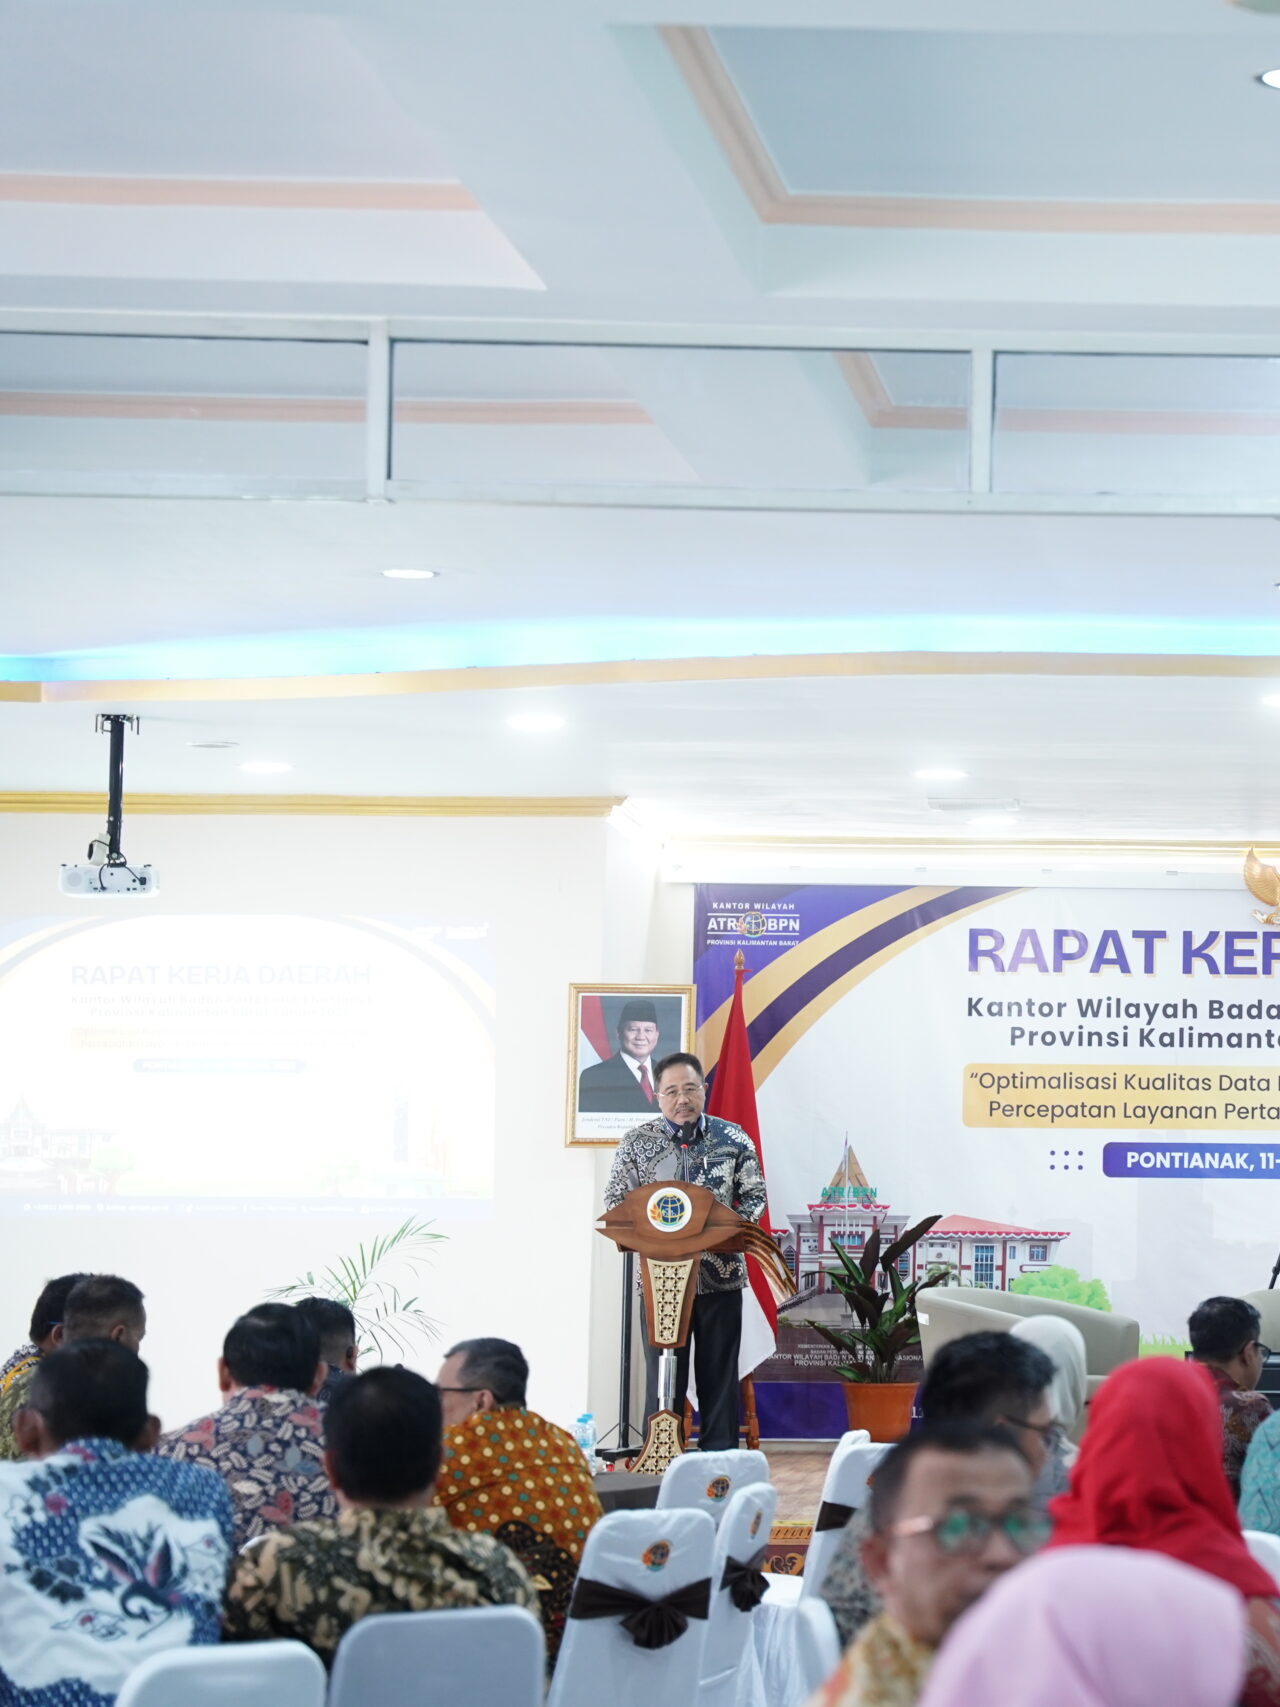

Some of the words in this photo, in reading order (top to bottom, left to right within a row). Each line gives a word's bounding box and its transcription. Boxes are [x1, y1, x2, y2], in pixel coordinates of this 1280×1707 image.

[713, 902, 750, 910] KANTOR
[707, 917, 736, 930] ATR
[768, 918, 800, 931] BPN
[968, 928, 1168, 974] RAPAT
[71, 965, 160, 985] RAPAT
[168, 965, 250, 985] KERJA
[258, 965, 371, 985] DAERAH
[968, 997, 1067, 1018] Kantor
[1077, 998, 1198, 1025] Wilayah
[1011, 1026, 1129, 1048] Provinsi
[1124, 1073, 1212, 1091] Kualitas
[1220, 1074, 1270, 1092] Data
[989, 1100, 1116, 1124] Percepatan
[1123, 1102, 1217, 1125] Layanan
[1127, 1151, 1255, 1172] PONTIANAK,
[821, 1186, 878, 1198] ATR/BPN
